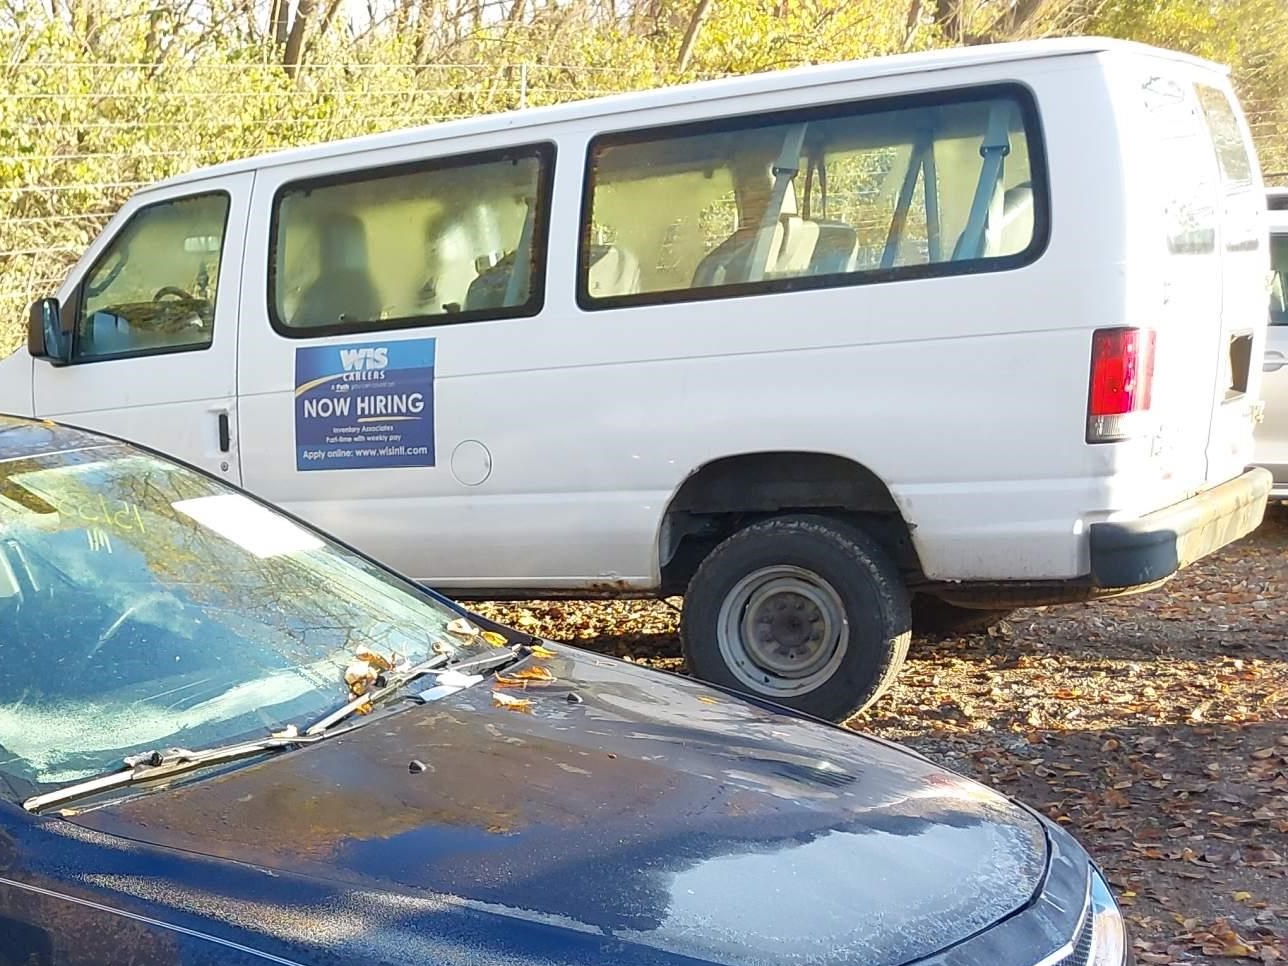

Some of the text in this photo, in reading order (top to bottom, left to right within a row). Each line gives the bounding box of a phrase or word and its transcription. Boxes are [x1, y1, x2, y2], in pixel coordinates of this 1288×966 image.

[340, 348, 388, 371] WIS
[343, 371, 385, 382] CAREERS
[304, 393, 425, 418] NOW HIRING
[303, 450, 325, 460] Apply
